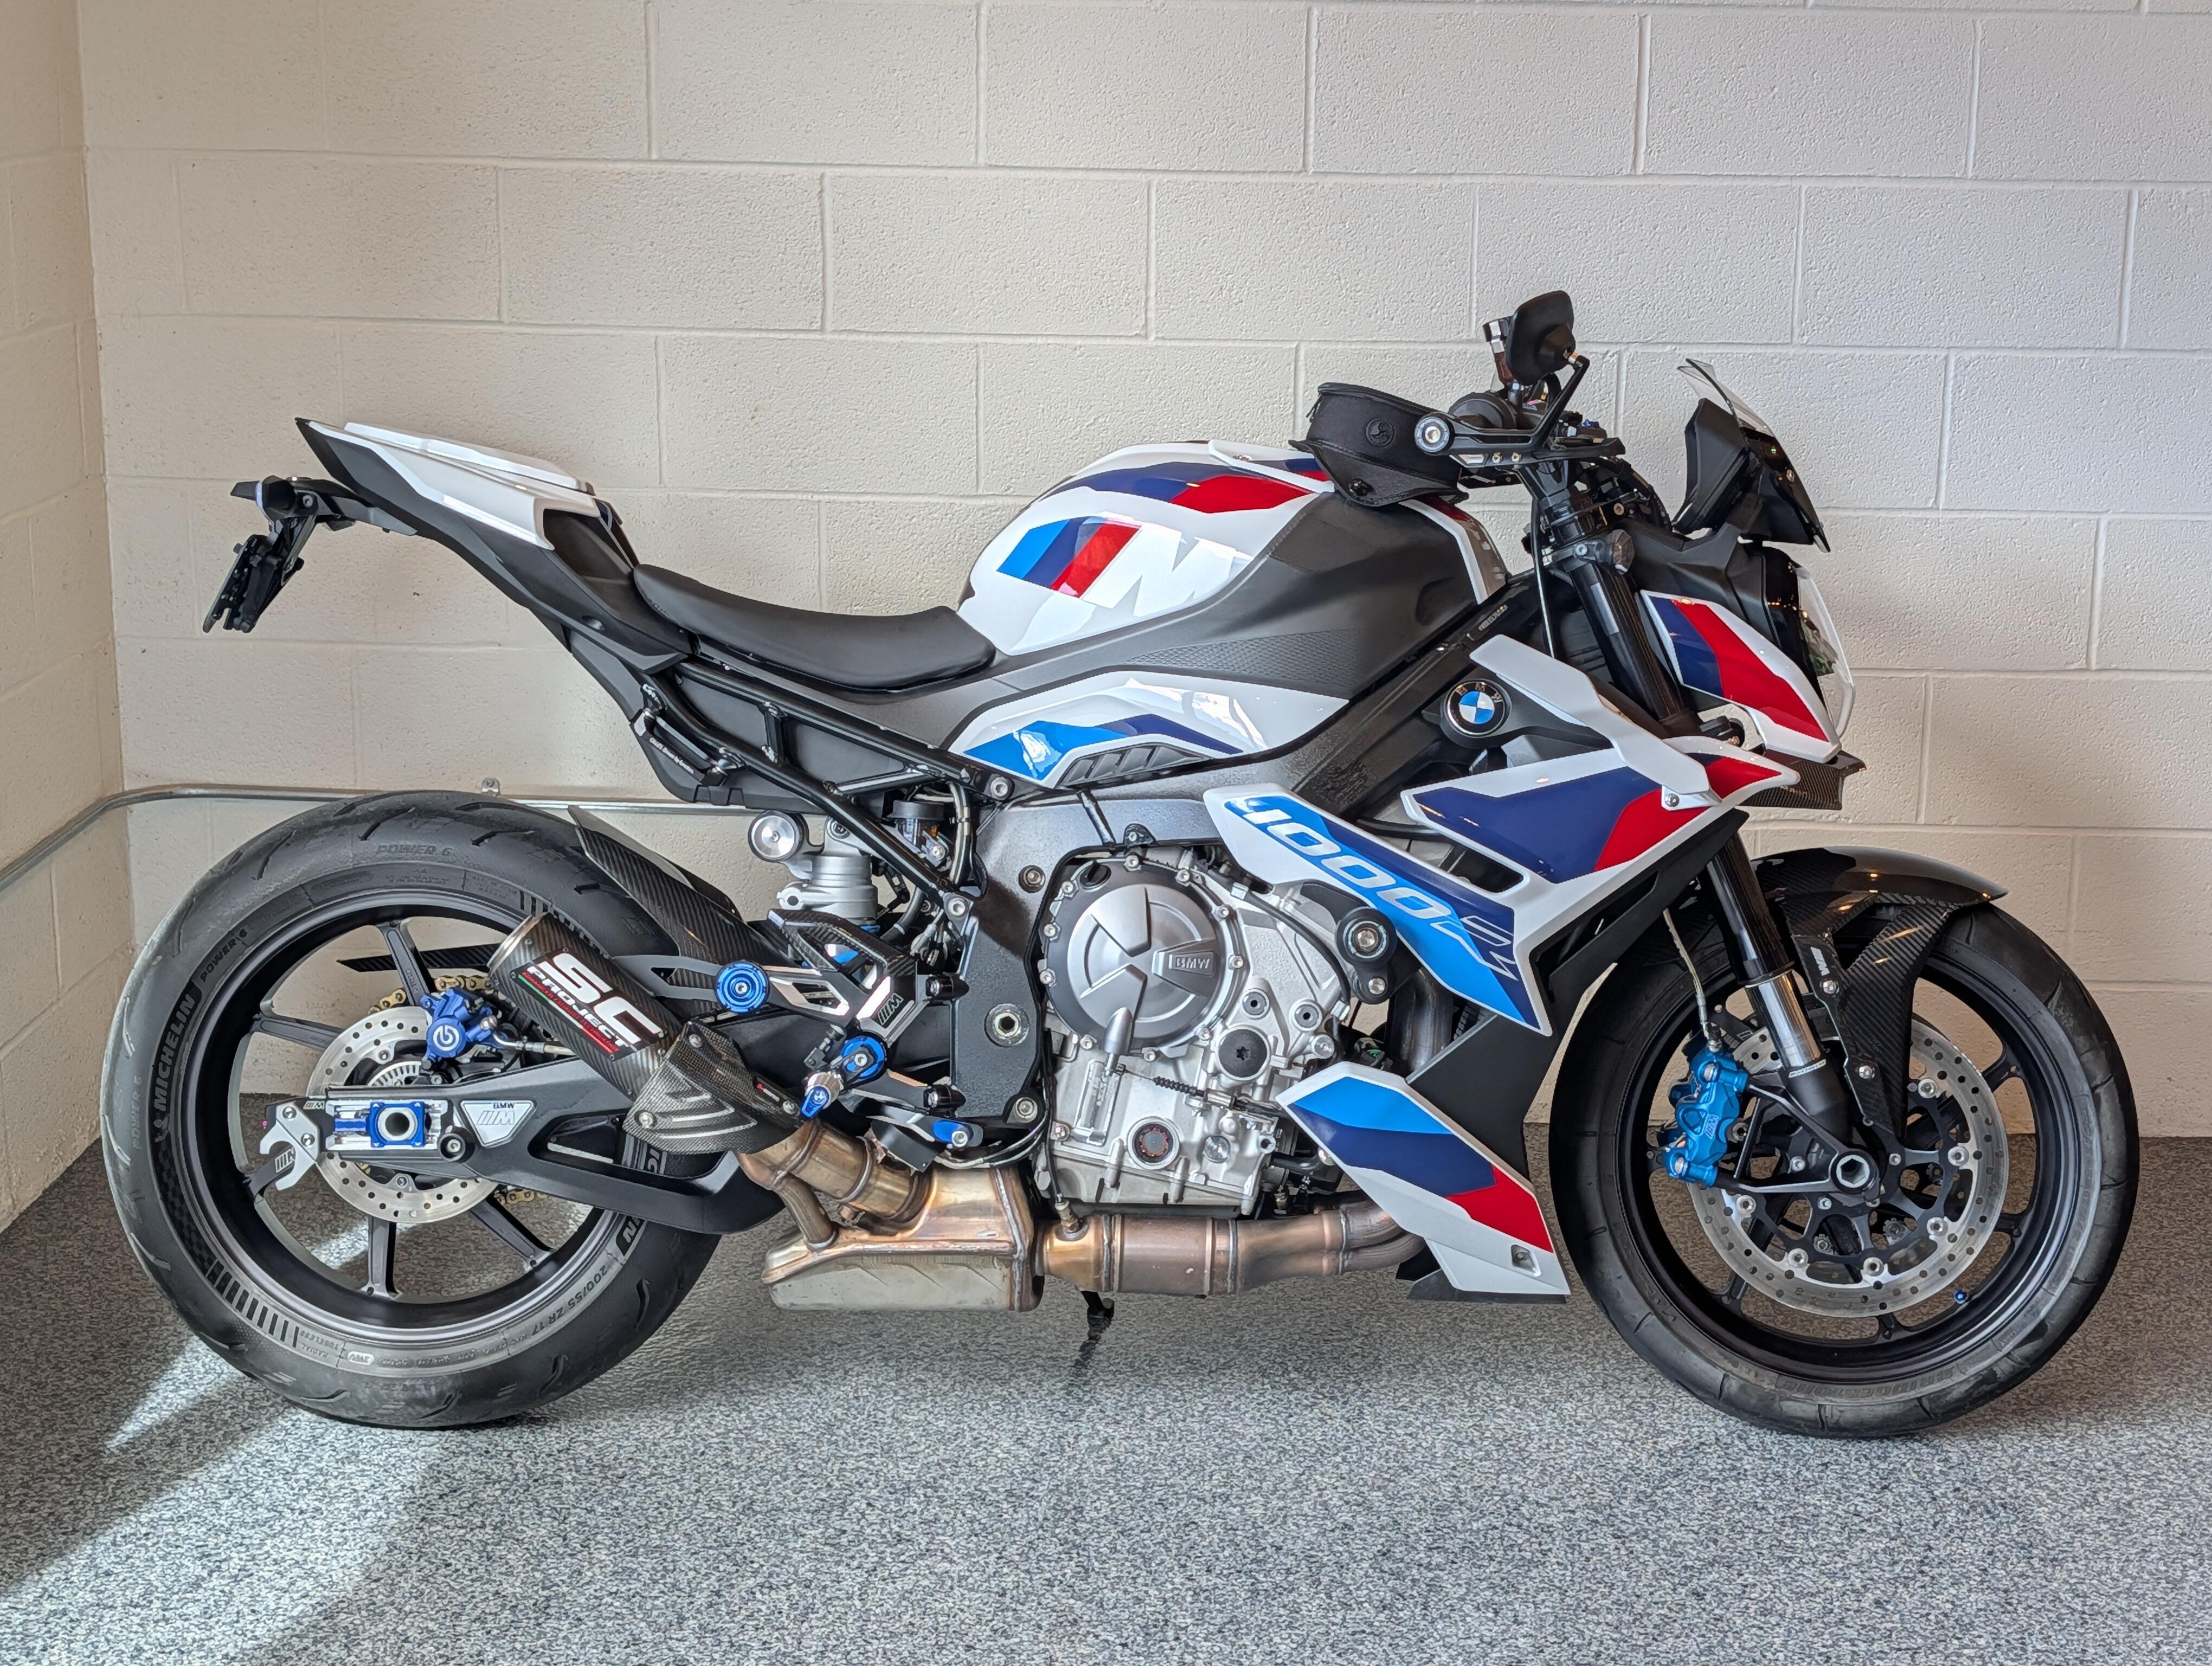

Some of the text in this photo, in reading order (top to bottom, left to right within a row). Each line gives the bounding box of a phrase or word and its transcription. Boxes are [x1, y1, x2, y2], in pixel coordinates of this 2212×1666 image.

[375, 844, 436, 855] POWER
[1243, 806, 1452, 919] 1000
[200, 938, 237, 983] POWER
[1175, 957, 1210, 969] BMW
[526, 966, 631, 1048] PROJECT
[537, 953, 664, 1045] SC
[153, 994, 196, 1112] MICHELIN
[531, 1265, 608, 1336] 200/55 ZR 17
